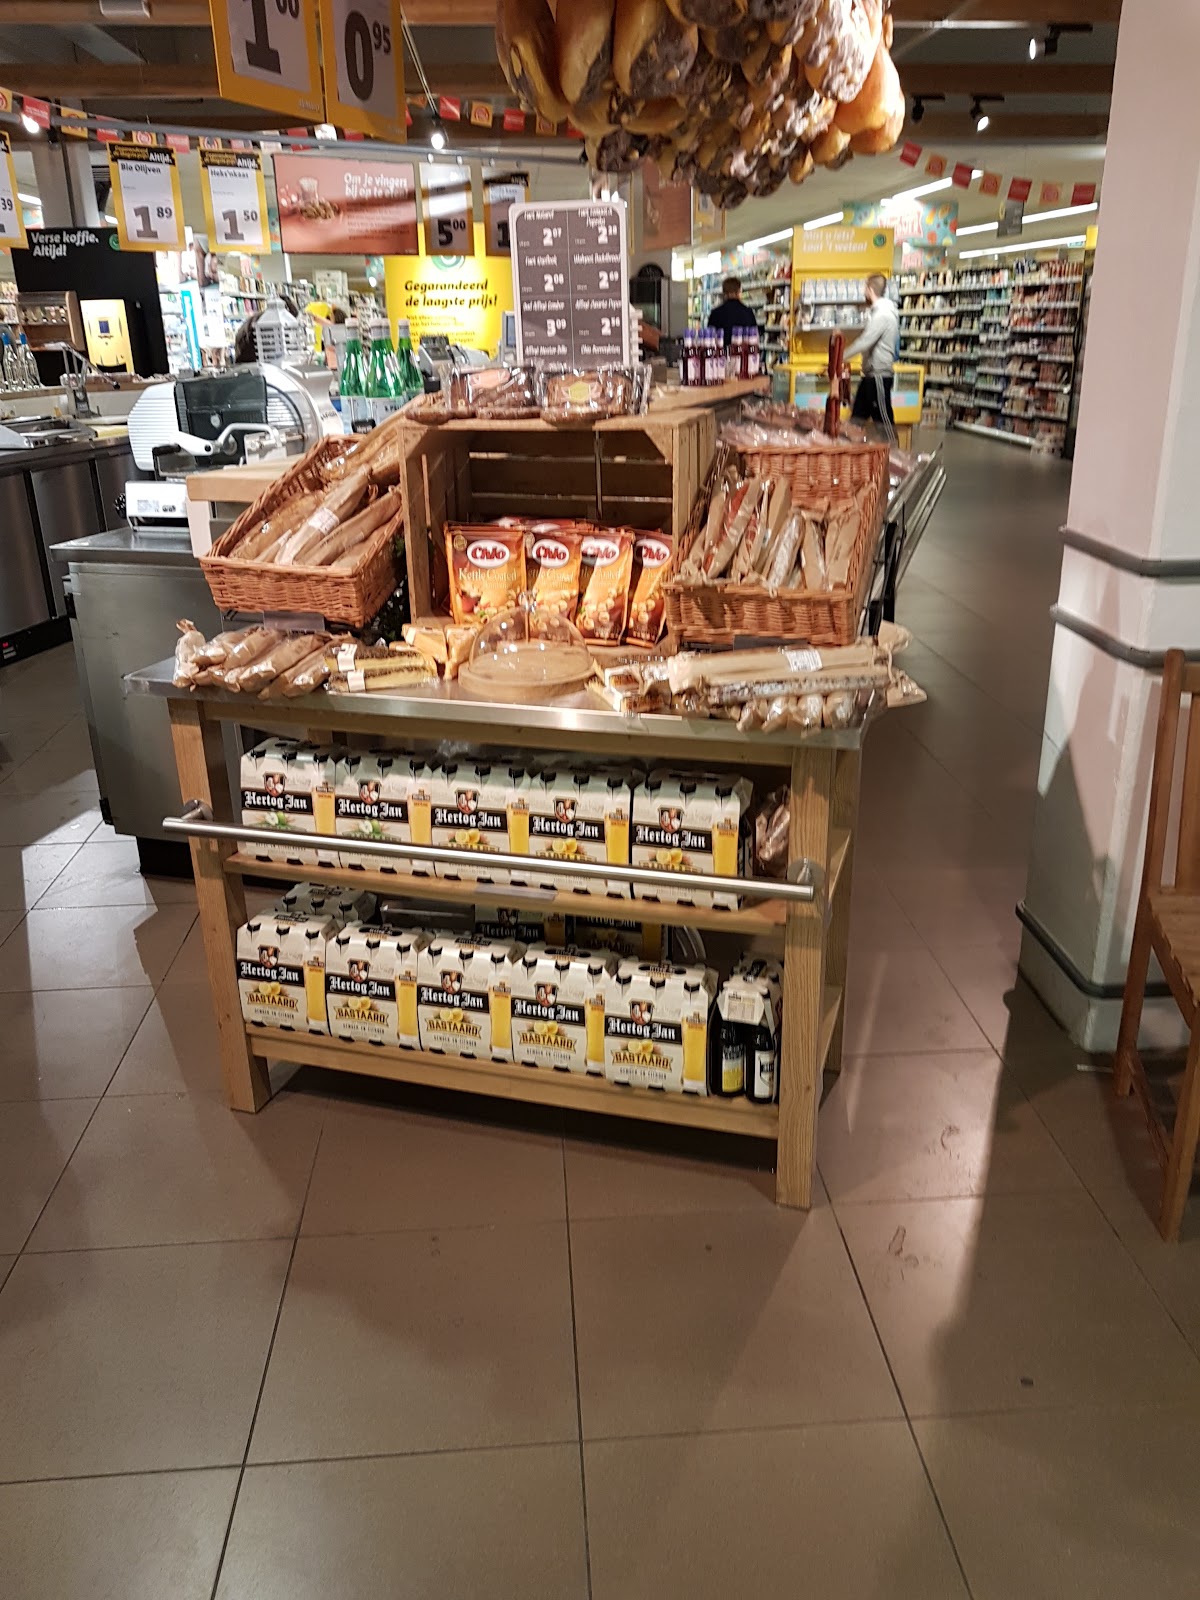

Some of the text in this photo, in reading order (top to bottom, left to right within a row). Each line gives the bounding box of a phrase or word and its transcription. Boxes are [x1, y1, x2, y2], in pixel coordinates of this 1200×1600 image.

[245, 0, 282, 75] 1
[345, 10, 391, 101] 0 95
[121, 163, 161, 175] Bio Olijven
[344, 172, 408, 188] Om je vingers
[345, 184, 358, 200] bij
[359, 186, 372, 200] op
[374, 186, 384, 197] te
[134, 206, 173, 240] 1 89
[222, 210, 258, 241] 1 50
[31, 230, 99, 247] Verse koffie.
[438, 219, 466, 247] 5 00
[543, 227, 553, 246] 2
[598, 224, 608, 244] 2
[33, 244, 67, 259] Altijd!
[404, 278, 488, 294] Gegarandeerd
[544, 273, 554, 292] 2
[599, 270, 609, 289] 2
[405, 293, 498, 309] de laagste prijs!
[547, 318, 556, 337] 3
[601, 316, 611, 336] 2
[472, 546, 506, 560] Chio
[536, 545, 567, 560] Chio
[459, 567, 518, 582] Kettle Coated
[244, 791, 308, 812] Hertog Jan
[338, 798, 403, 819] Hertog Jan
[434, 808, 502, 828] Hertog Jan
[532, 815, 599, 839] Hertog Jan
[636, 824, 706, 851] Hertog Jan
[240, 961, 300, 982] Hertog Jan
[329, 974, 391, 996] Hertog Jan
[249, 992, 296, 1008] BASTAARD
[420, 986, 484, 1008] Hertog Jan
[337, 1005, 386, 1022] BASTAARD
[514, 999, 580, 1022] Hertog Jan
[428, 1018, 478, 1036] BASTAARD
[607, 1016, 676, 1040] Hertog Jan
[521, 1032, 574, 1049] BASTAARD
[615, 1050, 669, 1068] BASTAARD
